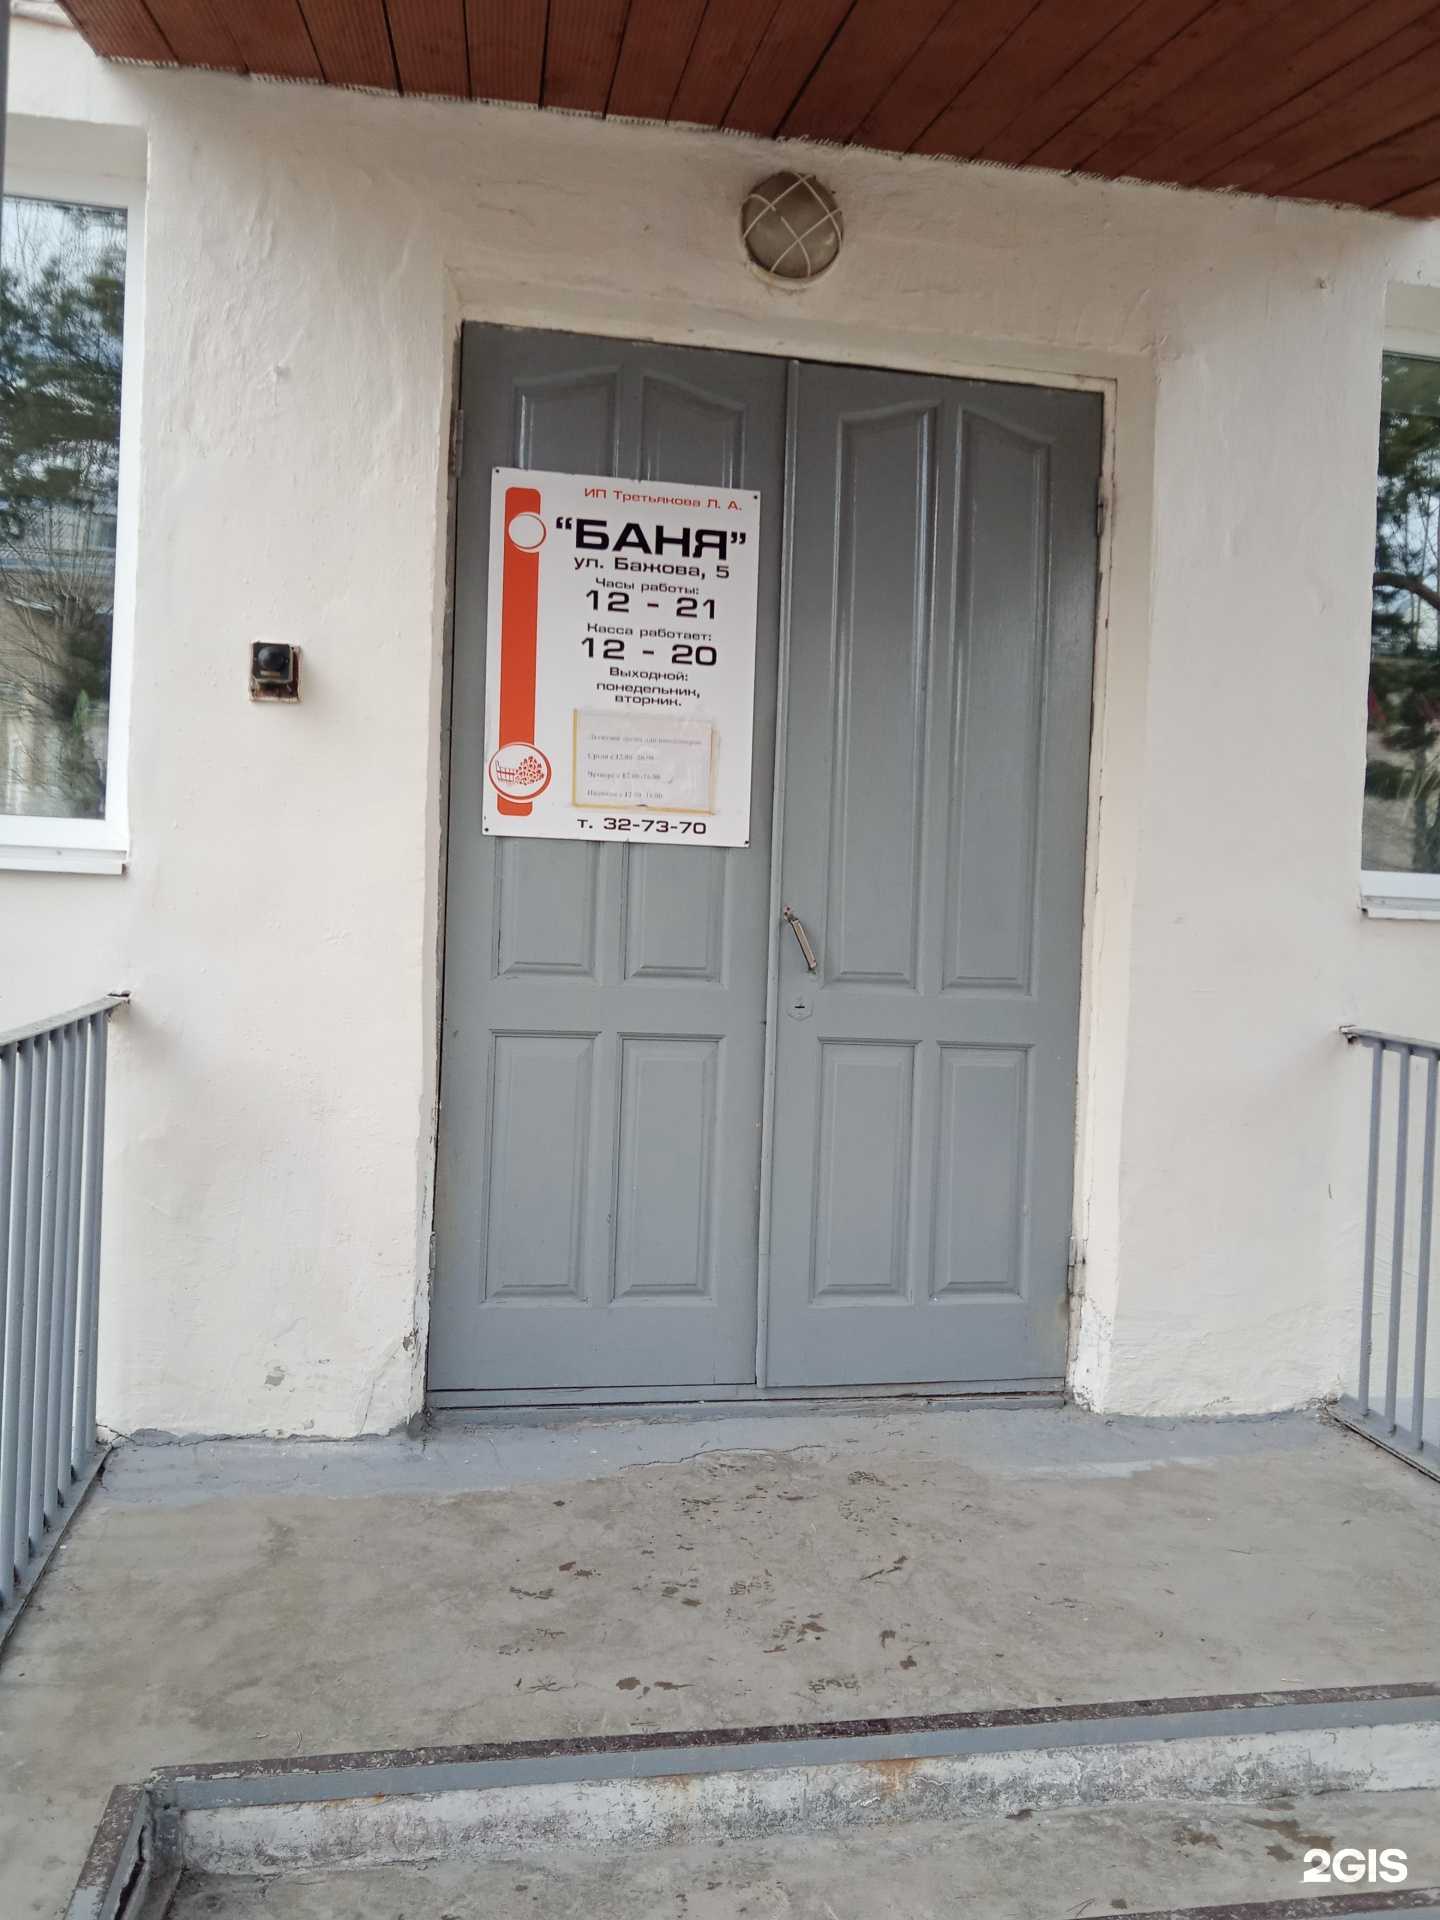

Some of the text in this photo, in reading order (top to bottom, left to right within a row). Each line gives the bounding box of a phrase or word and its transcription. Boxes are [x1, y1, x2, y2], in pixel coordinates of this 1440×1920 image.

[584, 488, 742, 510] ИП Третьякова Л. А.
[574, 557, 730, 580] ул. Бажова, 5
[595, 578, 699, 595] Часы работы:
[586, 590, 629, 612] 12
[676, 597, 716, 619] 21
[587, 624, 712, 641] Касса работает:
[581, 638, 625, 660] 12
[672, 644, 717, 666] 20
[610, 667, 688, 682] Выходной:
[596, 683, 700, 698] понедельник,
[615, 696, 682, 707] вторник.
[577, 818, 706, 835] т. 32-73-70
